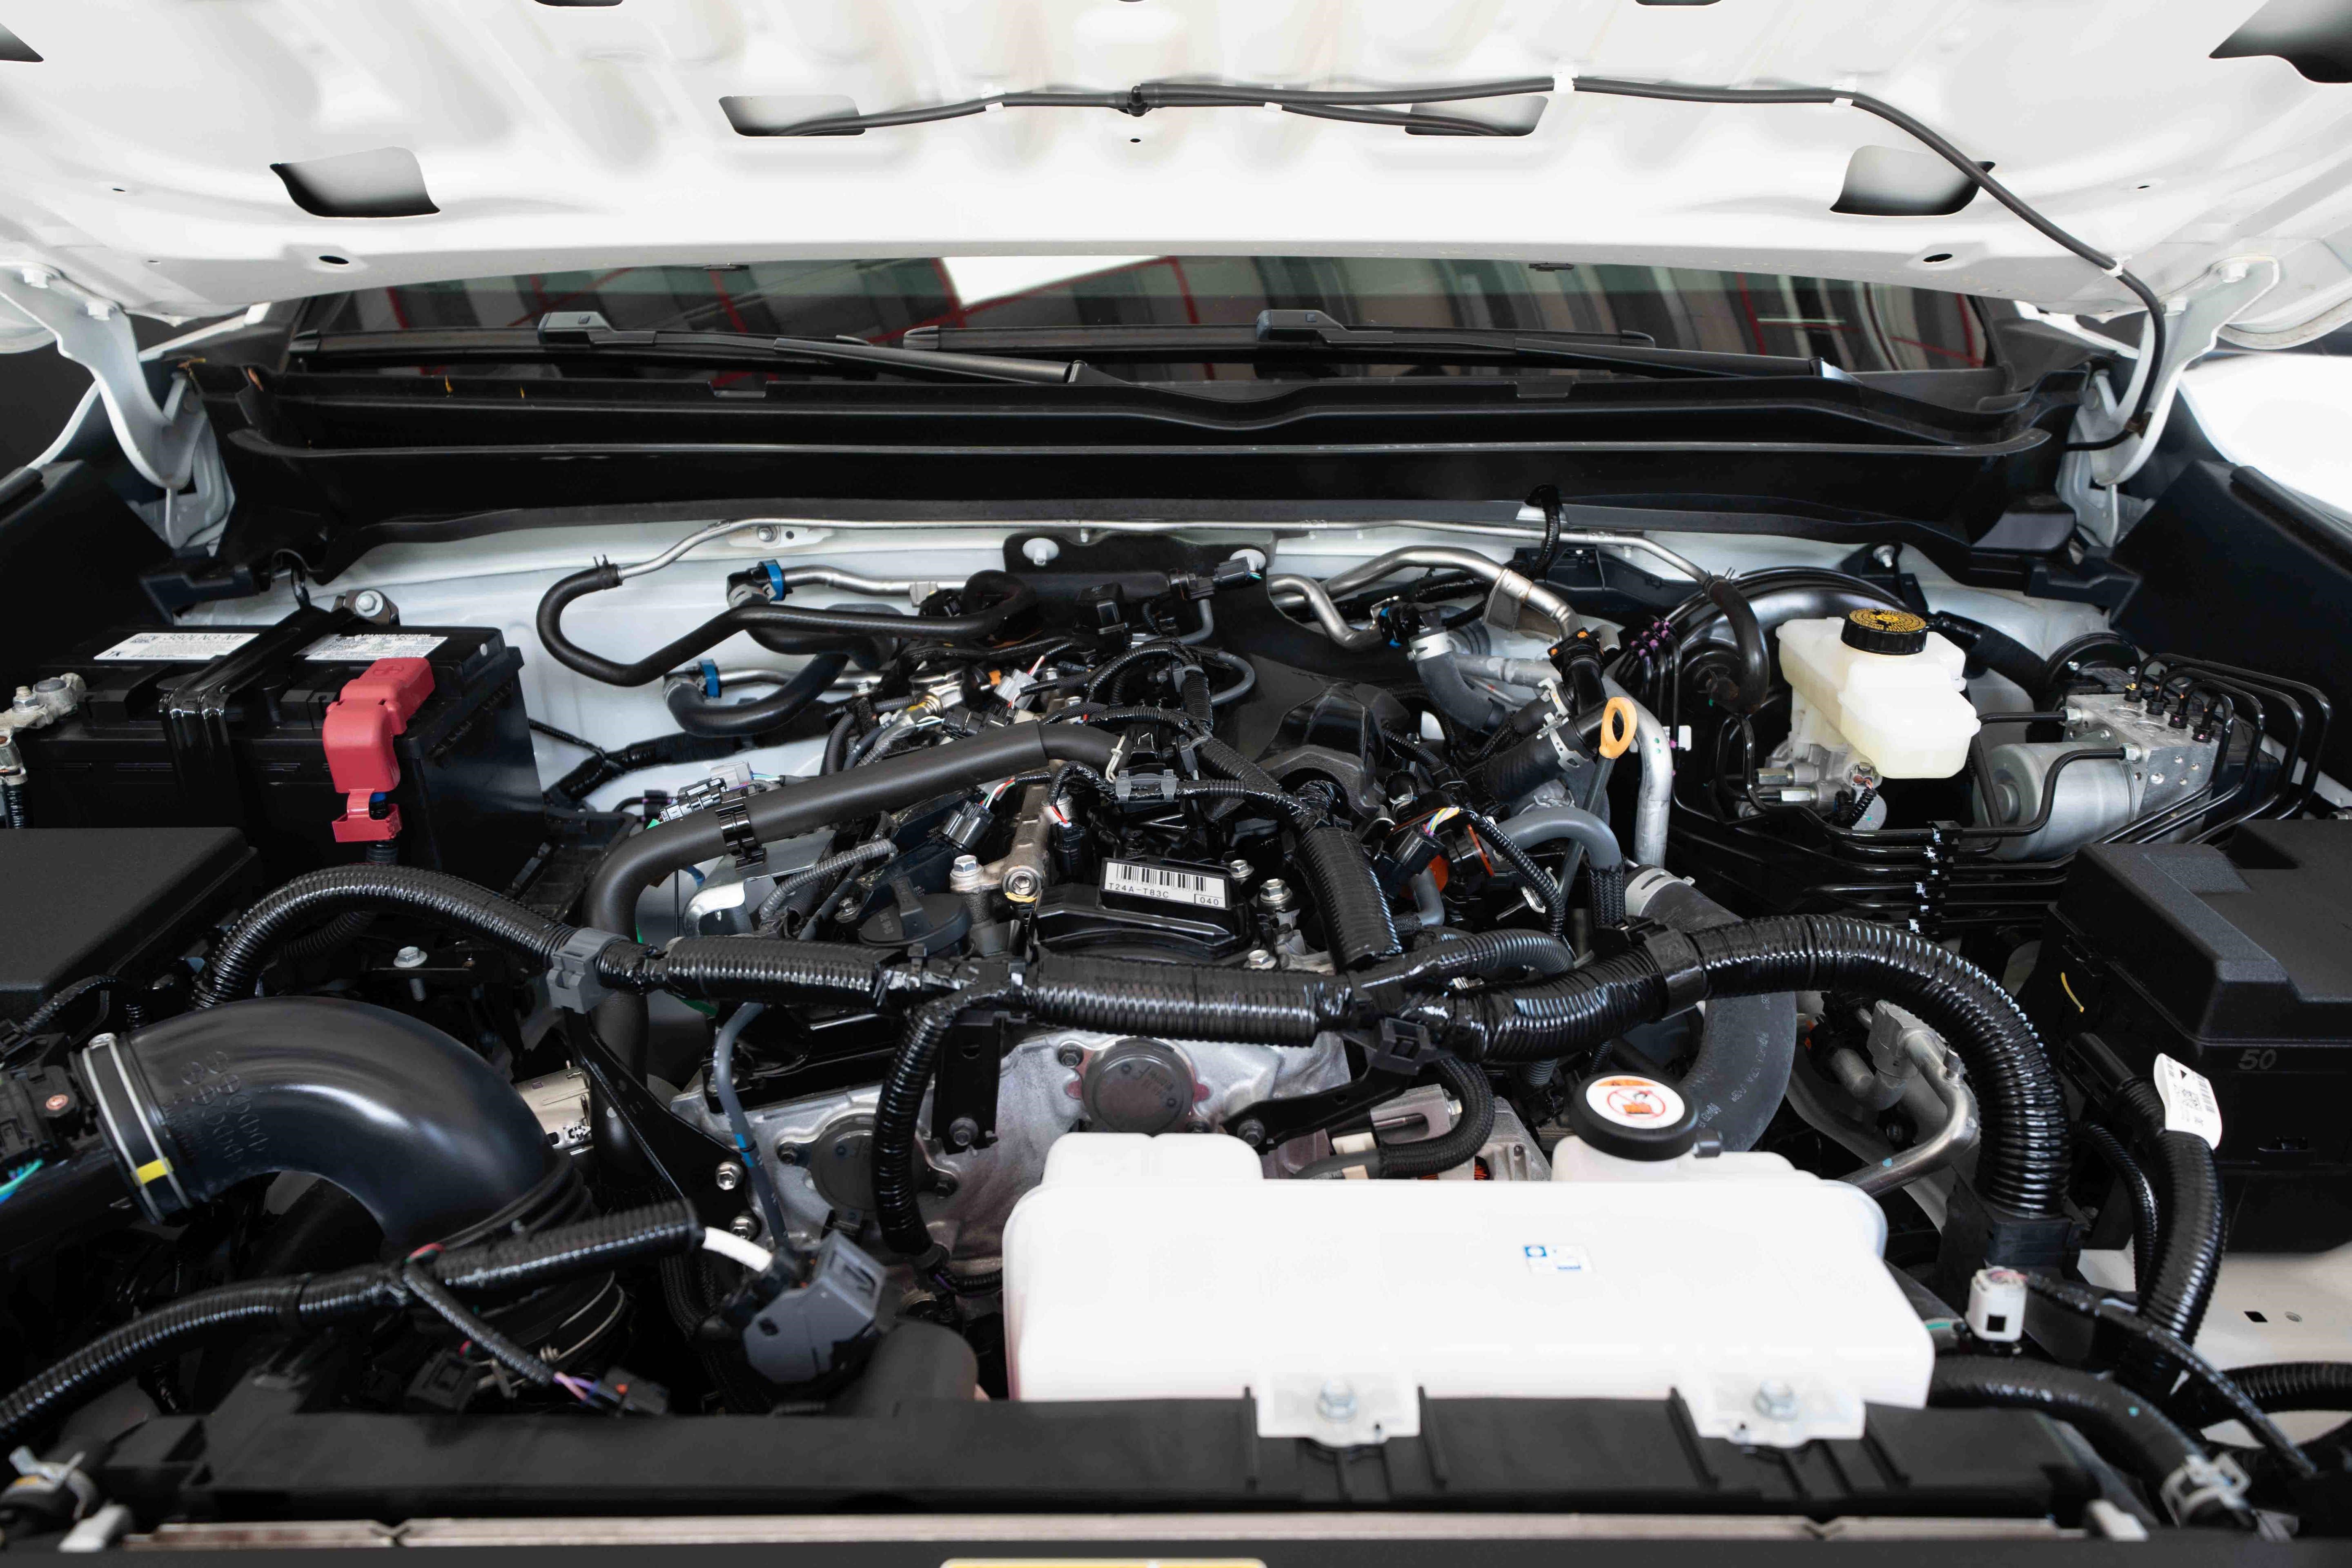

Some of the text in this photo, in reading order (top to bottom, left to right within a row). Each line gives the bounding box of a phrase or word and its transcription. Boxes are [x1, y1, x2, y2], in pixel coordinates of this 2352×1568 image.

[1109, 882, 1169, 898] T24A-T83C
[1200, 896, 1219, 906] 040
[2238, 1048, 2277, 1071] 50
